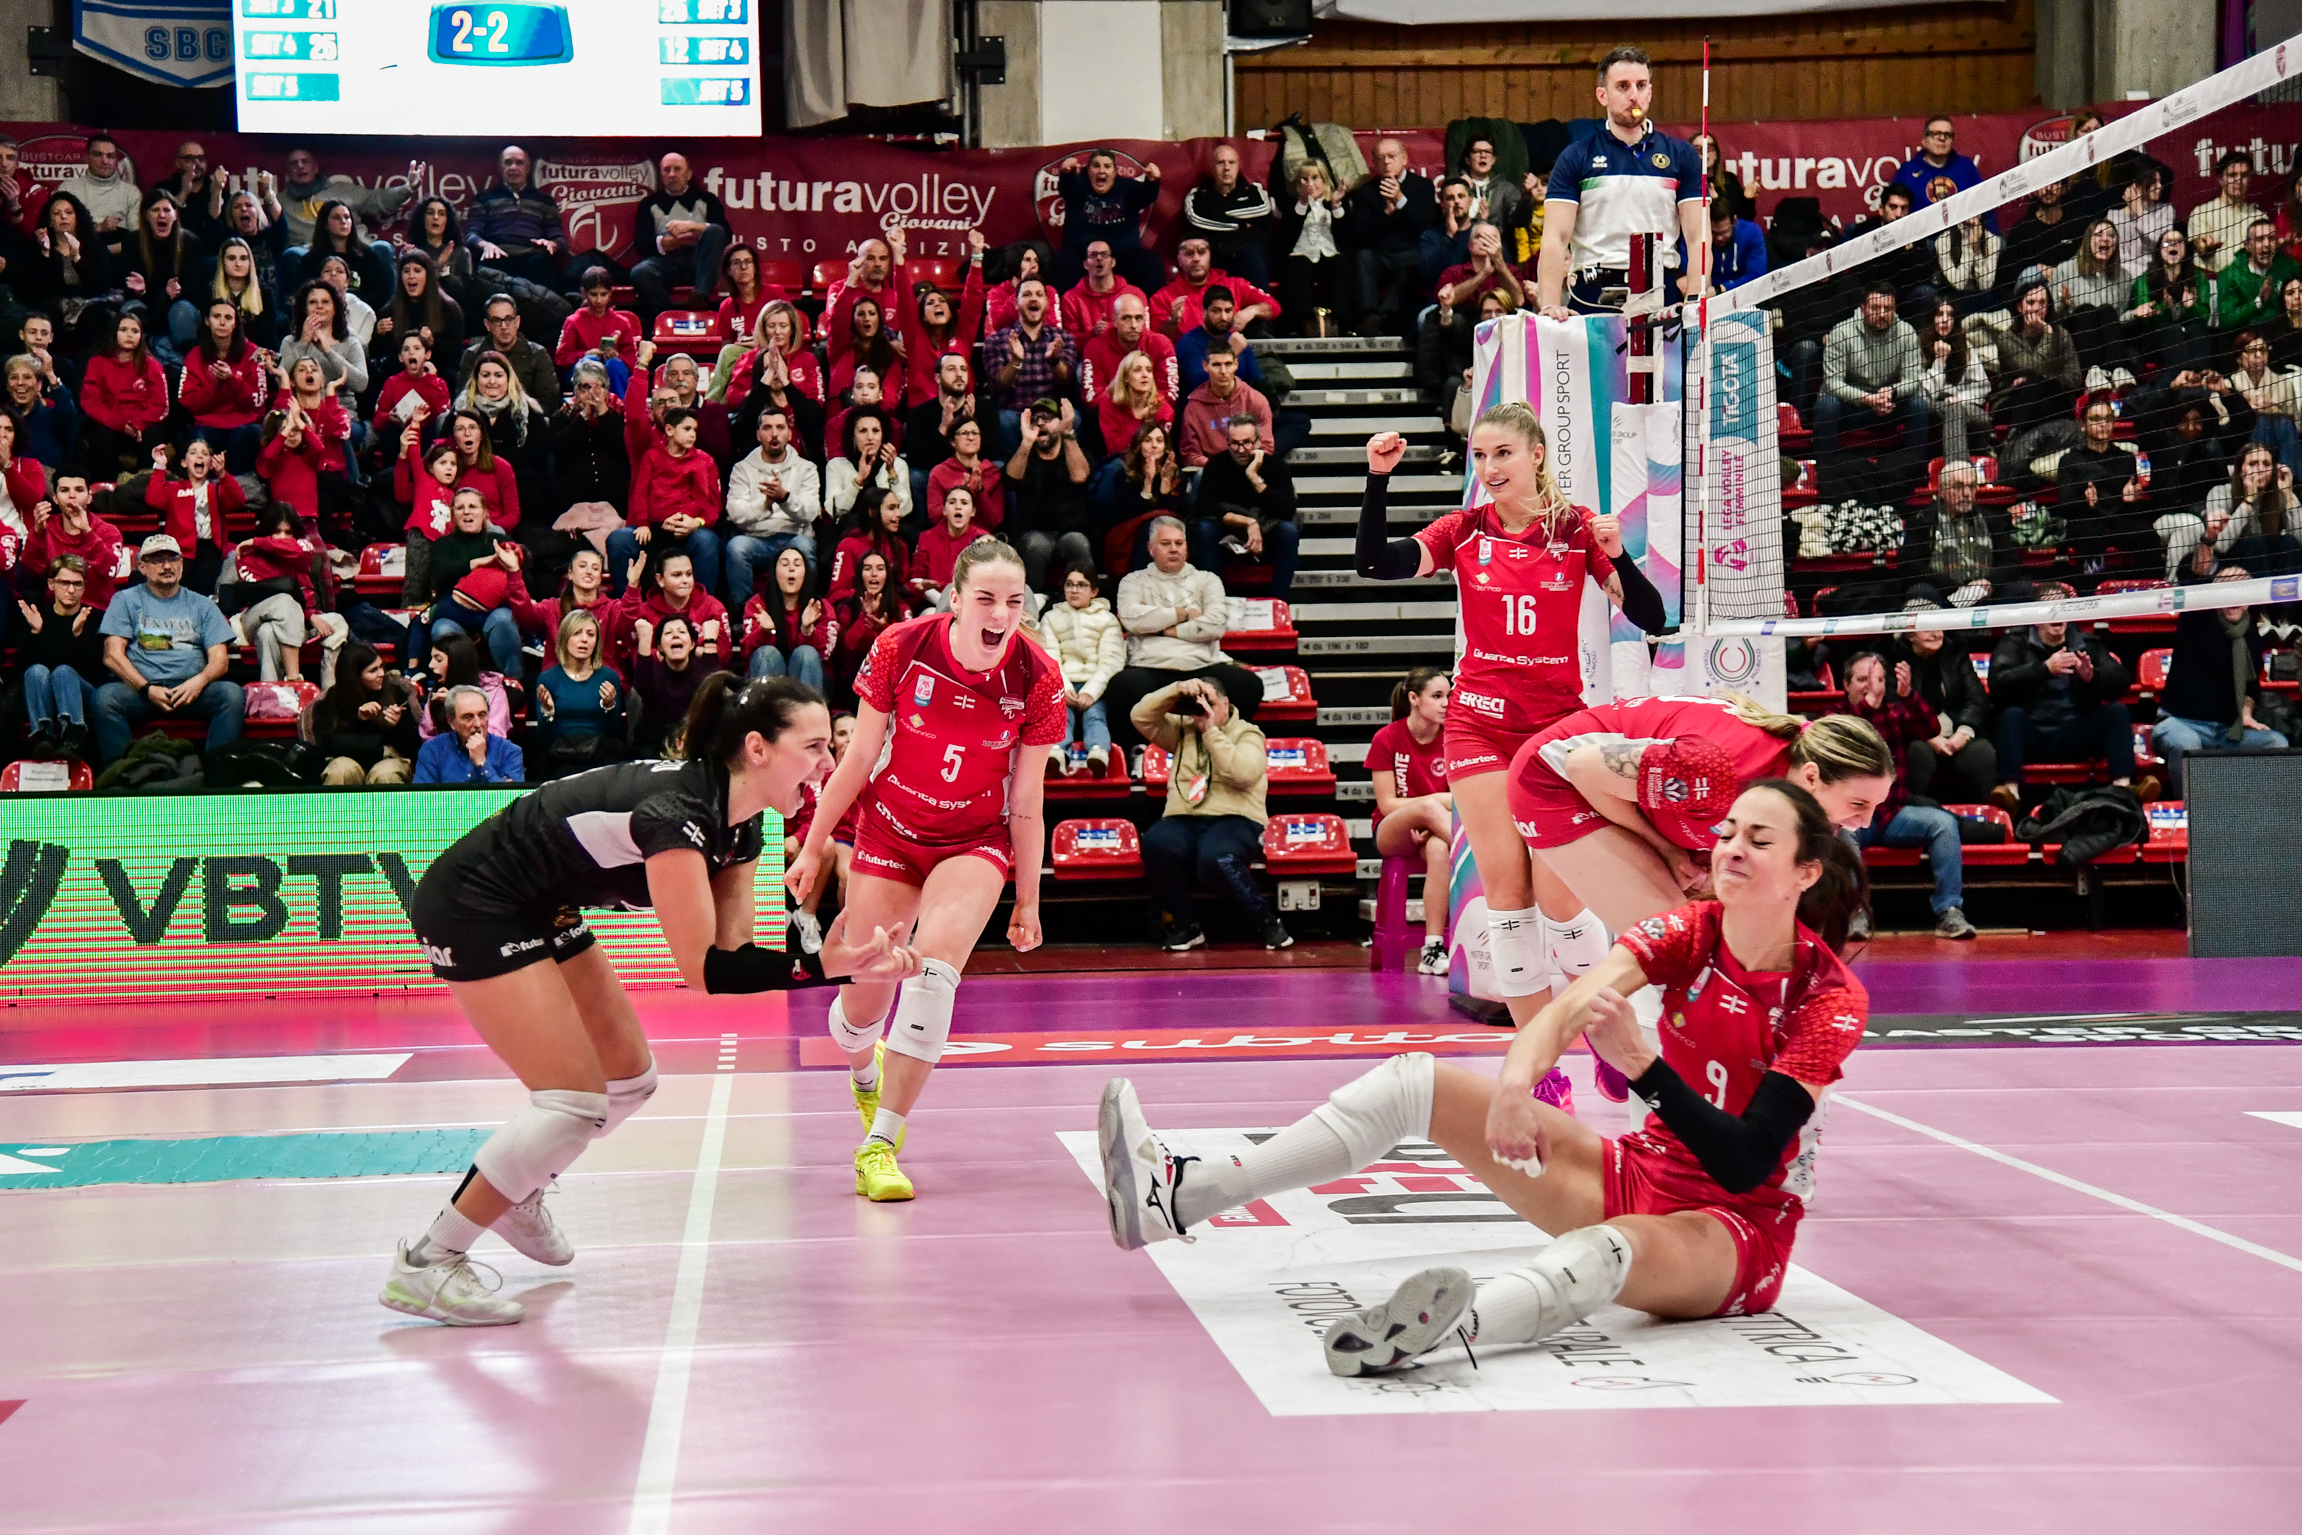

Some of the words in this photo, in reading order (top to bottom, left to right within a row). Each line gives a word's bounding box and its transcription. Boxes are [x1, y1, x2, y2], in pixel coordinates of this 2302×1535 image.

[308, 0, 334, 19] 21
[145, 26, 234, 62] SBC
[252, 34, 284, 54] SET
[284, 34, 298, 55] 4
[451, 10, 510, 53] 2-2
[664, 37, 690, 63] 12
[699, 39, 730, 60] SET
[729, 39, 744, 60] 4
[252, 76, 284, 97] SET
[285, 77, 299, 97] 5
[699, 80, 730, 101] SET
[730, 80, 744, 101] 5
[20, 152, 82, 162] BUSTOAR
[541, 165, 650, 181] futuravolley
[551, 182, 641, 213] Giovani
[703, 166, 996, 226] futuravolley
[880, 211, 973, 236] Giovani
[731, 235, 817, 252] USTO
[1555, 349, 1571, 404] SPORT
[1556, 405, 1572, 467] GROUP
[1722, 449, 1733, 496] VOLLEY
[1734, 454, 1745, 526] FEMMINILE
[1722, 500, 1733, 530] LEGA
[1501, 594, 1537, 636] 16
[1473, 648, 1516, 664] Quanta
[1516, 655, 1569, 666] System
[1459, 690, 1505, 714] ERRECI
[1332, 713, 1342, 722] da
[940, 743, 966, 783] 5
[887, 774, 937, 808] Quanta
[865, 853, 906, 871] futurtec
[1034, 1031, 1517, 1051] subito
[1705, 1059, 1729, 1110] 9
